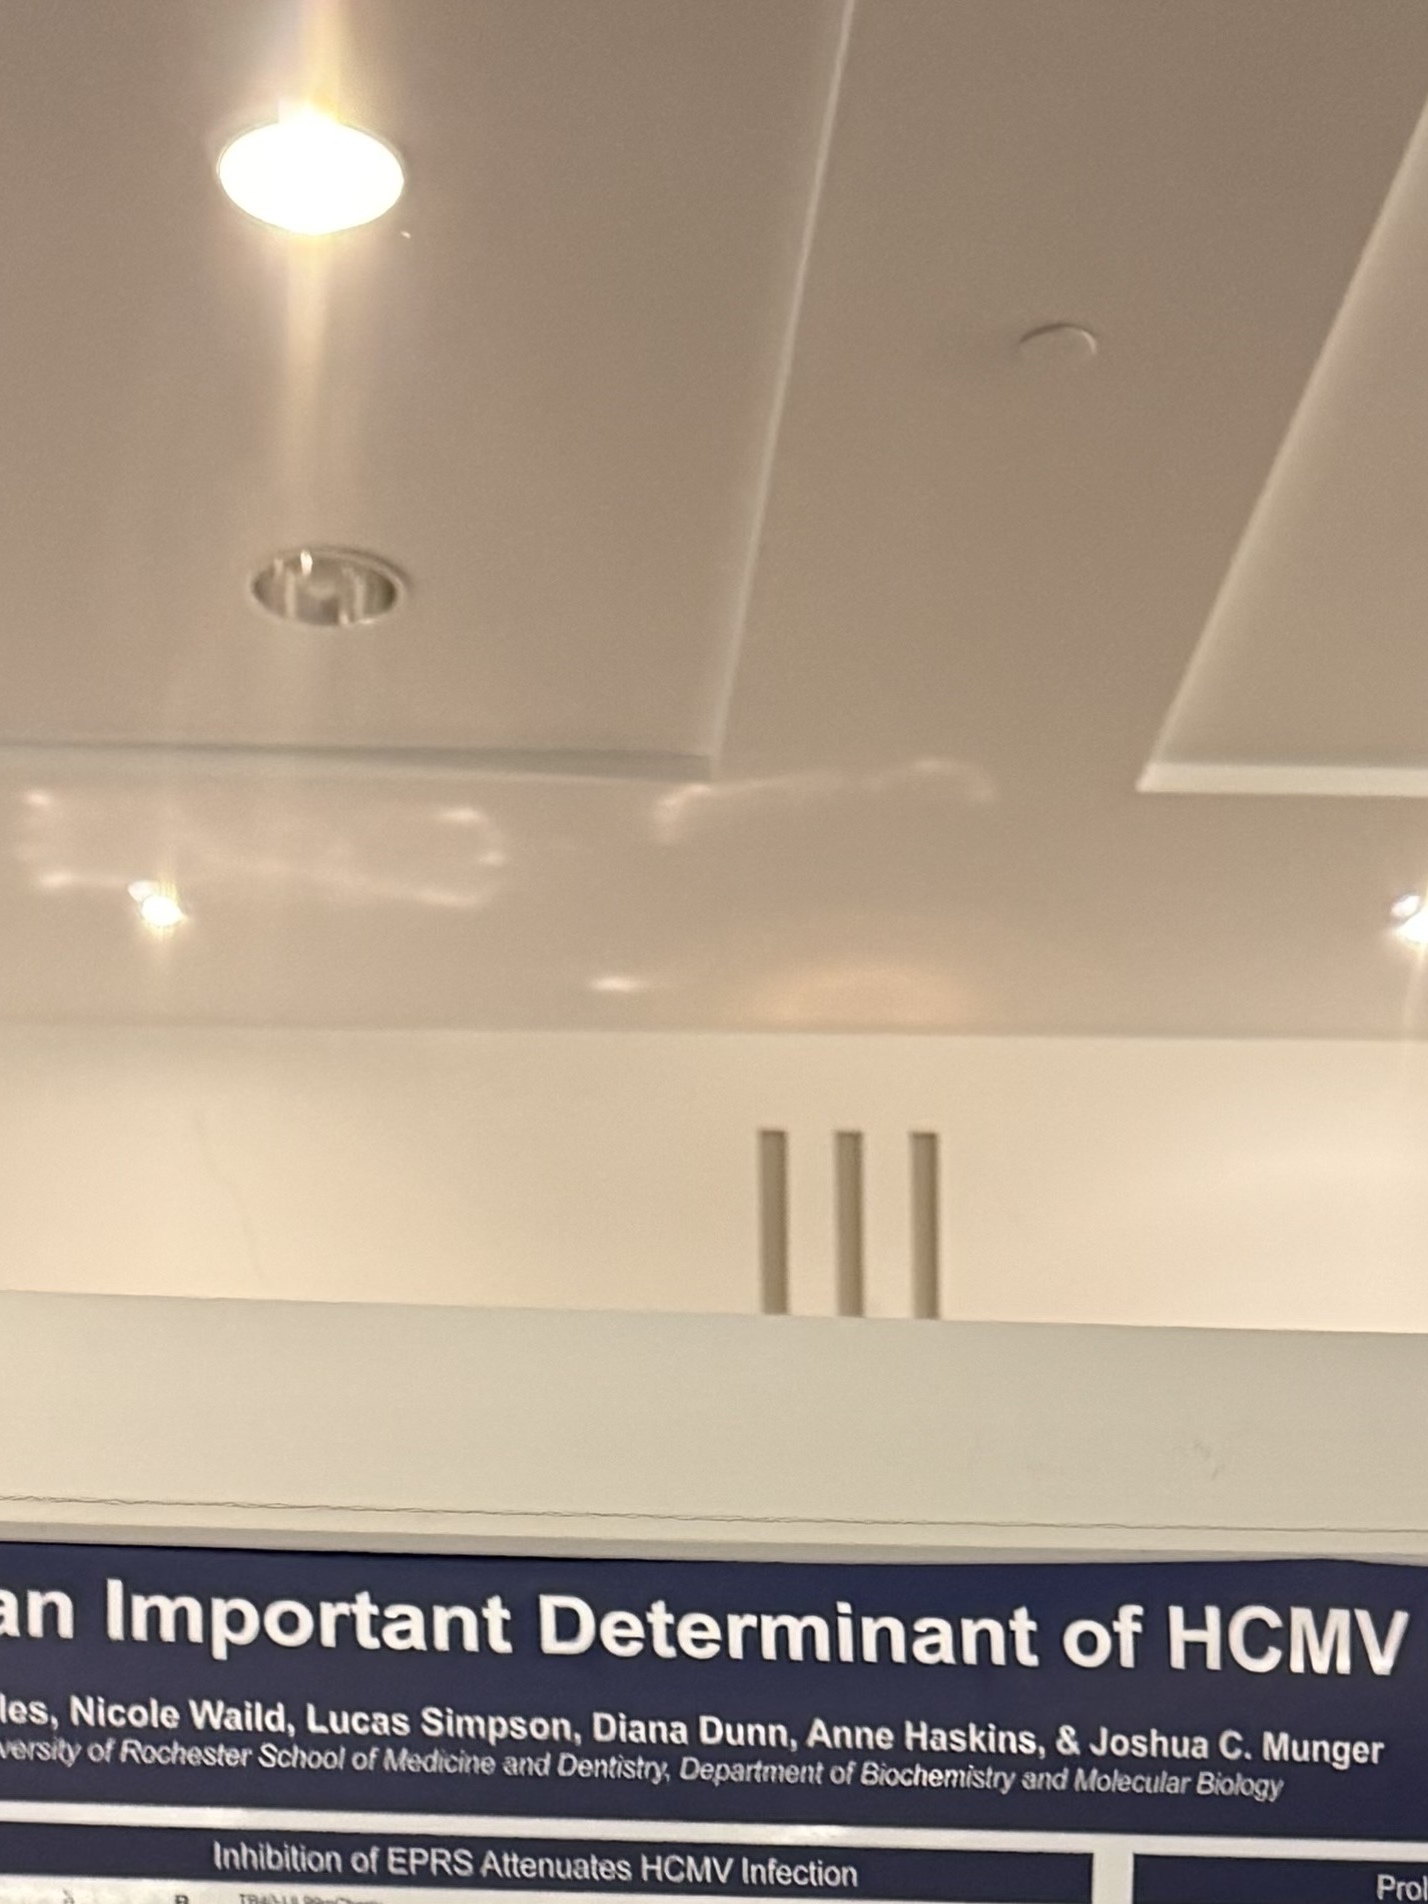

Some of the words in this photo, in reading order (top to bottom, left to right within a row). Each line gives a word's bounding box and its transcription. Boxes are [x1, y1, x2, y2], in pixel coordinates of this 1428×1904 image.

[107, 1578, 512, 1661] Important
[539, 1594, 1039, 1667] Determinant
[1063, 1604, 1144, 1668] of
[1169, 1605, 1410, 1675] HCMV
[70, 1695, 180, 1729] Nicole
[189, 1699, 295, 1738] Waild,
[306, 1702, 411, 1736] Lucas
[421, 1706, 582, 1746] Simpson,
[592, 1712, 689, 1745] Diana
[699, 1715, 798, 1752] Dunn,
[807, 1718, 894, 1750] Anne
[905, 1720, 1046, 1759] Haskins,
[1056, 1724, 1081, 1755] &
[1090, 1726, 1209, 1759] Joshua
[1219, 1729, 1252, 1760] C.
[1263, 1731, 1385, 1770] Munger
[86, 1737, 116, 1763] of
[119, 1738, 253, 1767] Rochester
[257, 1743, 346, 1770] School
[351, 1746, 380, 1771] of
[383, 1747, 496, 1775] Medicine
[502, 1752, 552, 1777] and
[557, 1752, 670, 1785] Dentistry,
[679, 1756, 824, 1787] Department
[829, 1760, 856, 1785] of
[860, 1760, 1016, 1794] Biochemistry
[1021, 1767, 1069, 1791] and
[1074, 1767, 1192, 1794] Molecular
[1196, 1771, 1284, 1802] Biology
[213, 1841, 342, 1873] Inhibition
[350, 1845, 380, 1874] of
[387, 1846, 473, 1877] EPRS
[480, 1849, 632, 1881] Attenuates
[641, 1854, 734, 1883] HCMV
[741, 1857, 858, 1887] Infection
